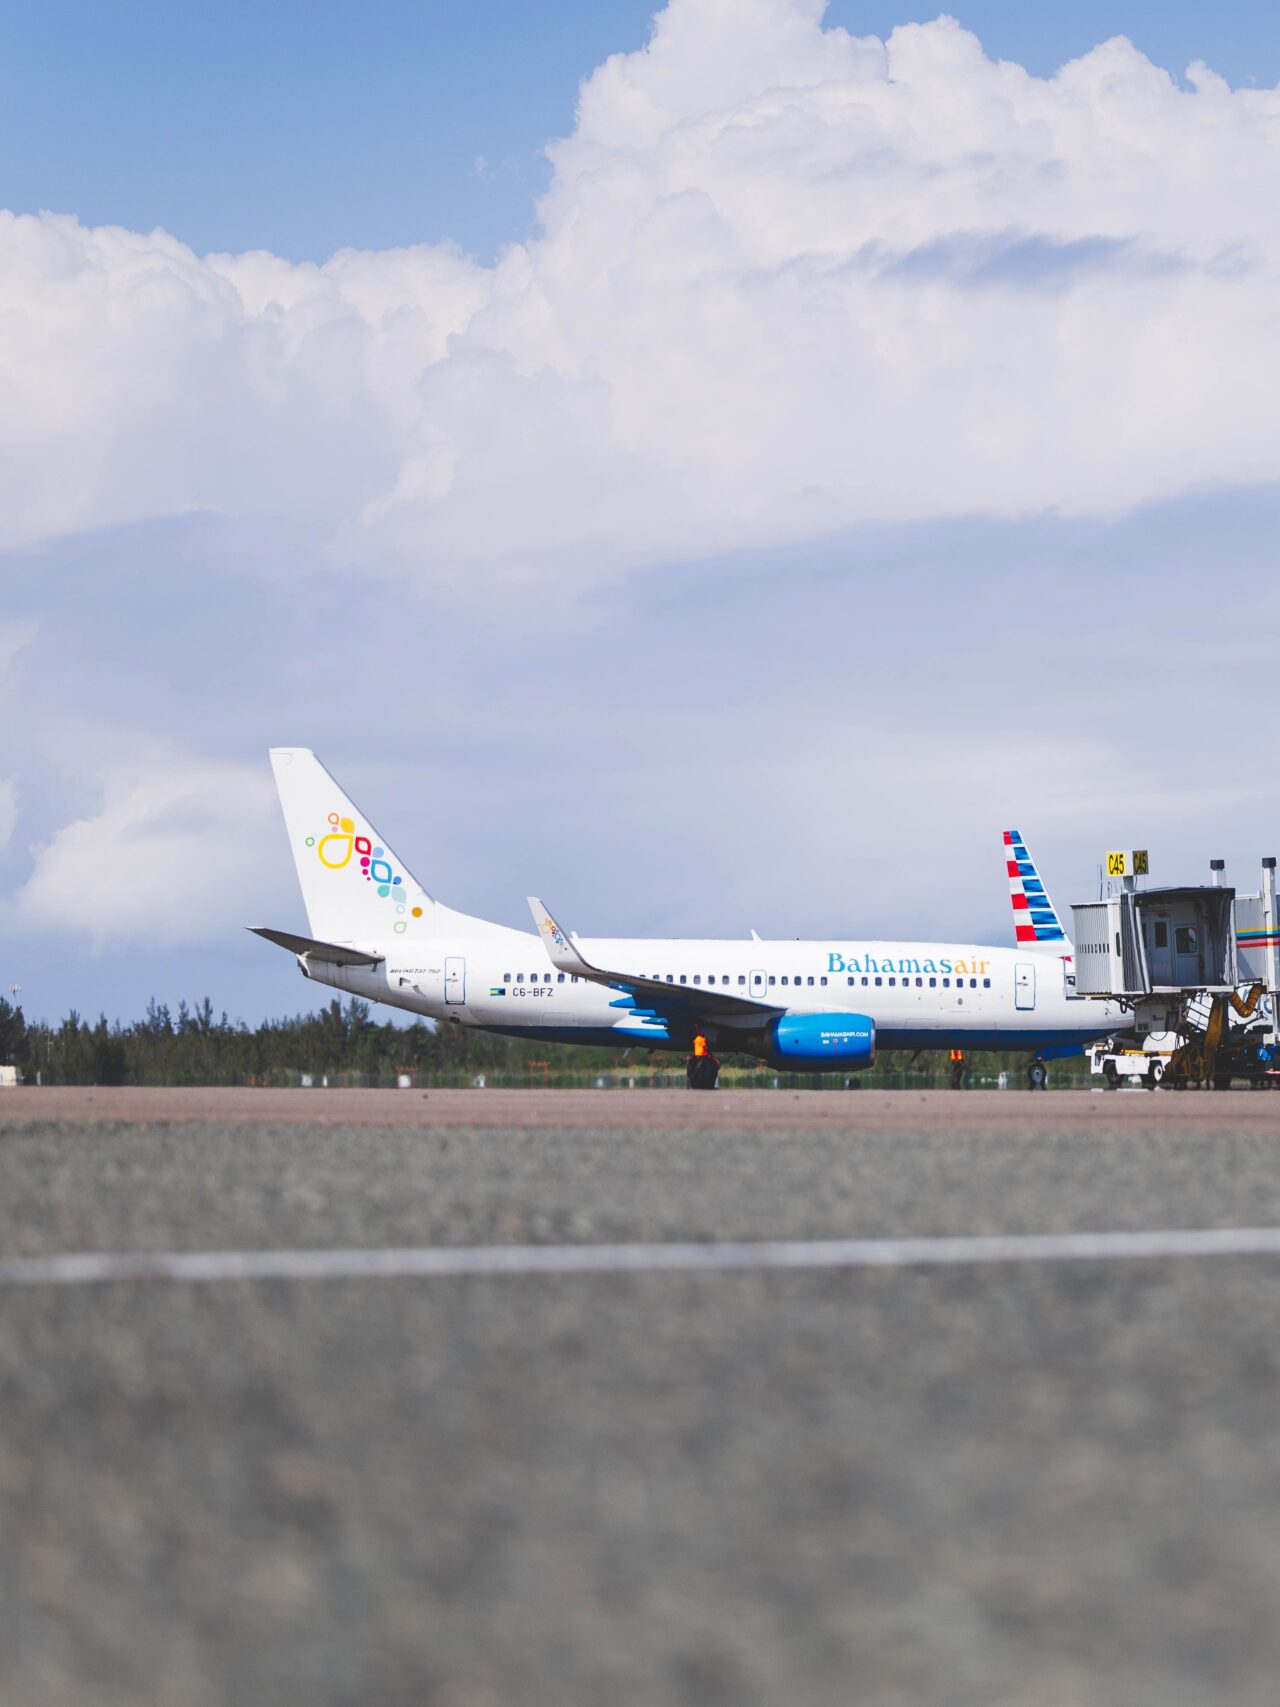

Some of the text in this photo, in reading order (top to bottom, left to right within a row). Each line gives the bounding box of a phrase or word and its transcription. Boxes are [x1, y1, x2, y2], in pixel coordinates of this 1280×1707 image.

[1108, 853, 1125, 875] C45
[1133, 852, 1147, 874] C45
[827, 952, 991, 975] Bahamasair
[512, 987, 554, 998] C6-BFZ
